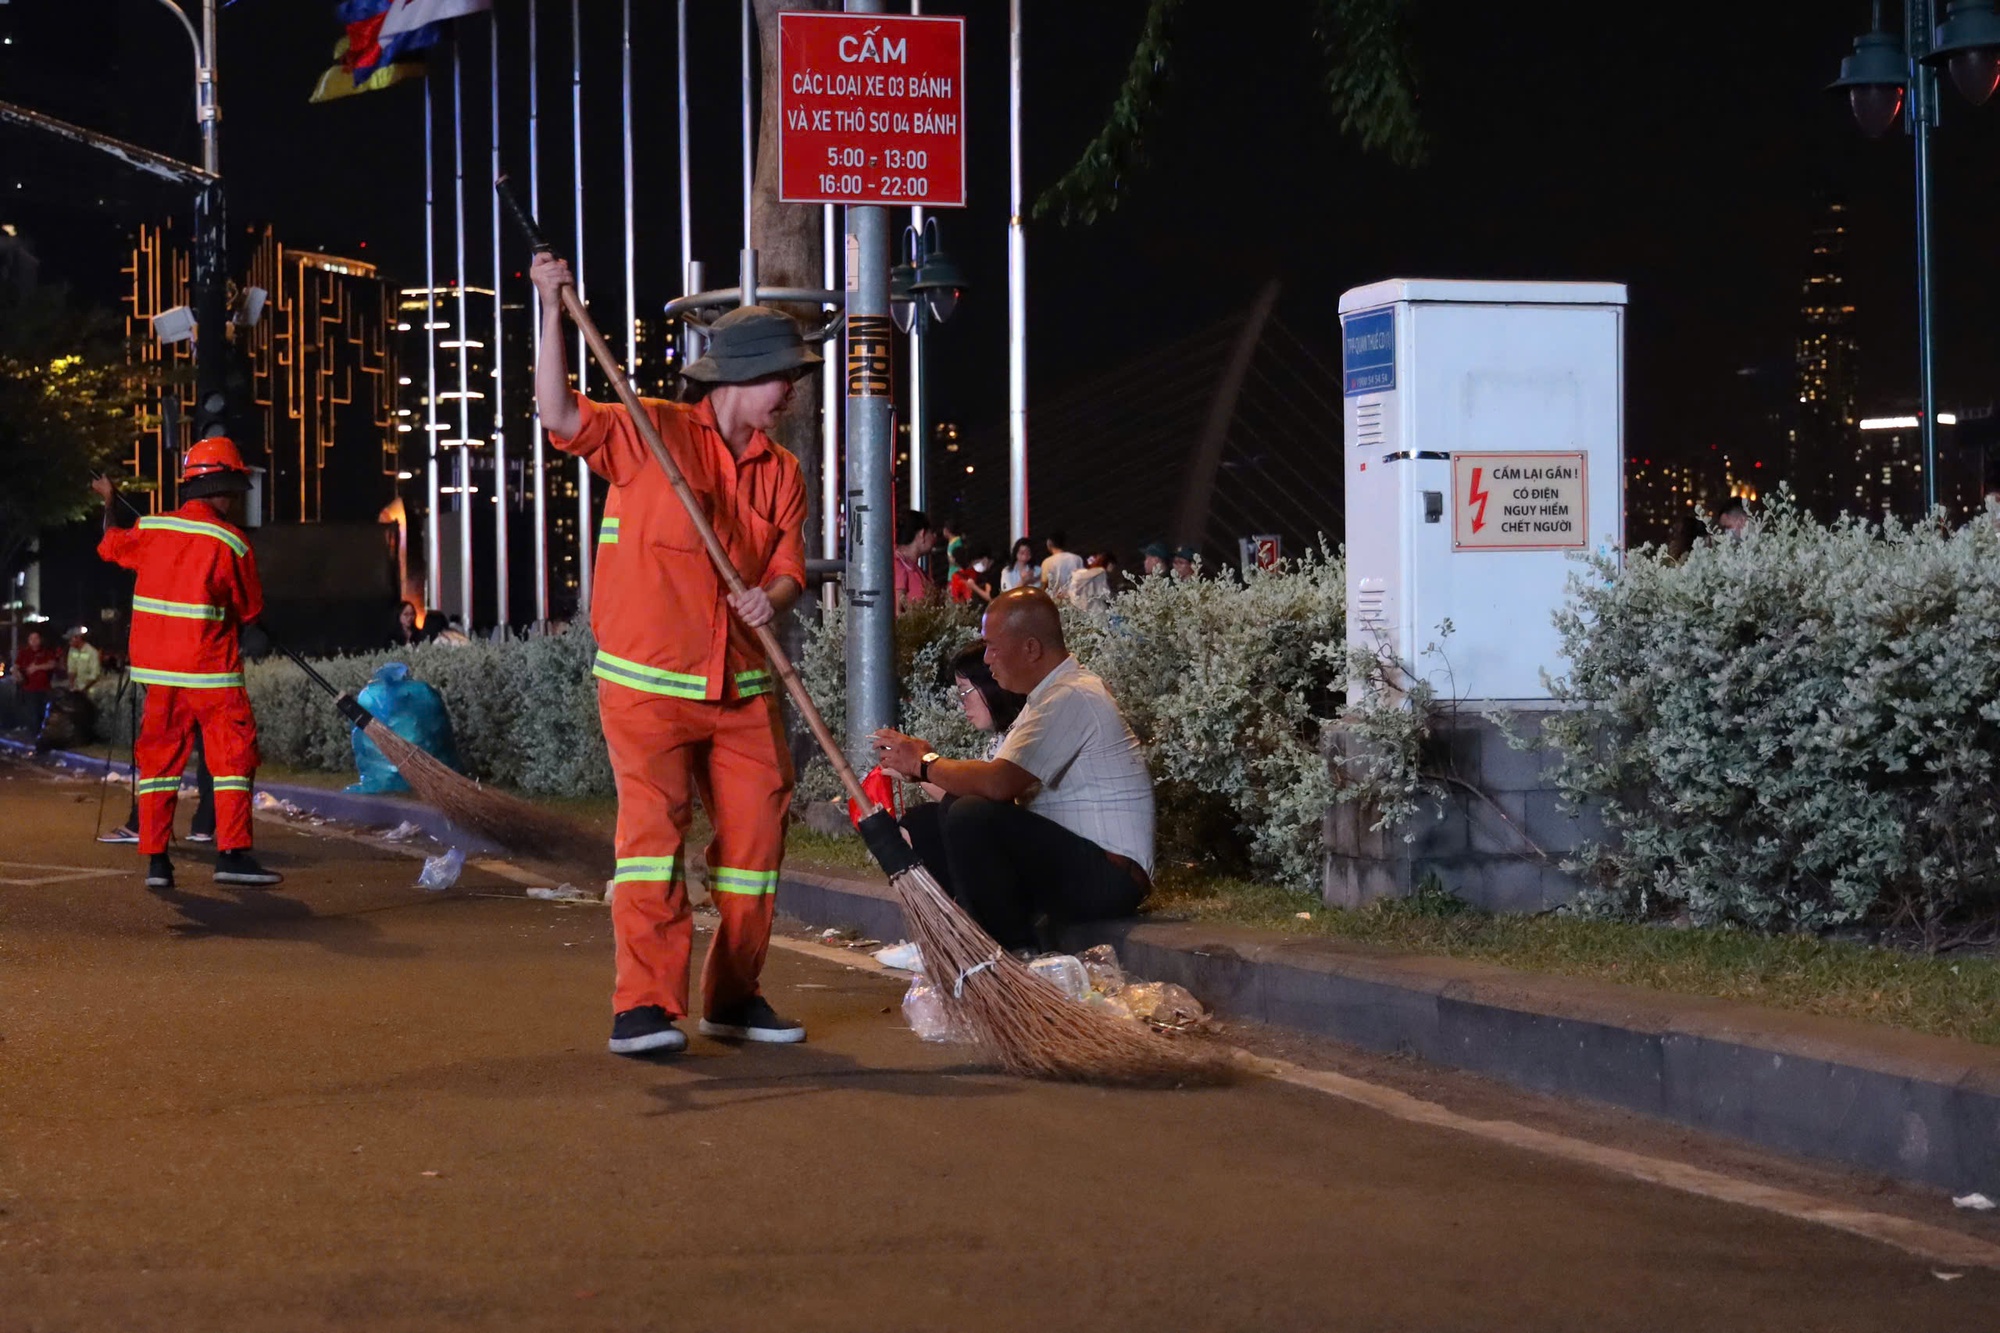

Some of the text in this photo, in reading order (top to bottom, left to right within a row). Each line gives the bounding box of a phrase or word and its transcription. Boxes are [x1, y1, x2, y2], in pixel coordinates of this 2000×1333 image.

[838, 25, 907, 64] CẤM
[792, 68, 951, 101] CÁC LOẠI XE 03 BÁNH
[787, 103, 809, 131] VÀ
[812, 110, 832, 131] XE
[835, 106, 866, 132] THÔ
[893, 112, 910, 133] 04
[914, 107, 957, 135] BÁNH
[827, 147, 865, 168] 5:00
[884, 149, 927, 170] 13:00
[819, 174, 862, 195] 16:00
[880, 176, 928, 197] 22:00
[1493, 465, 1520, 480] CẤM
[1523, 468, 1542, 483] LẠI
[1513, 486, 1559, 502] CÓ ĐIỆN
[1503, 505, 1537, 516] NGUY
[1501, 519, 1572, 533] CHẾT NGƯỜI
